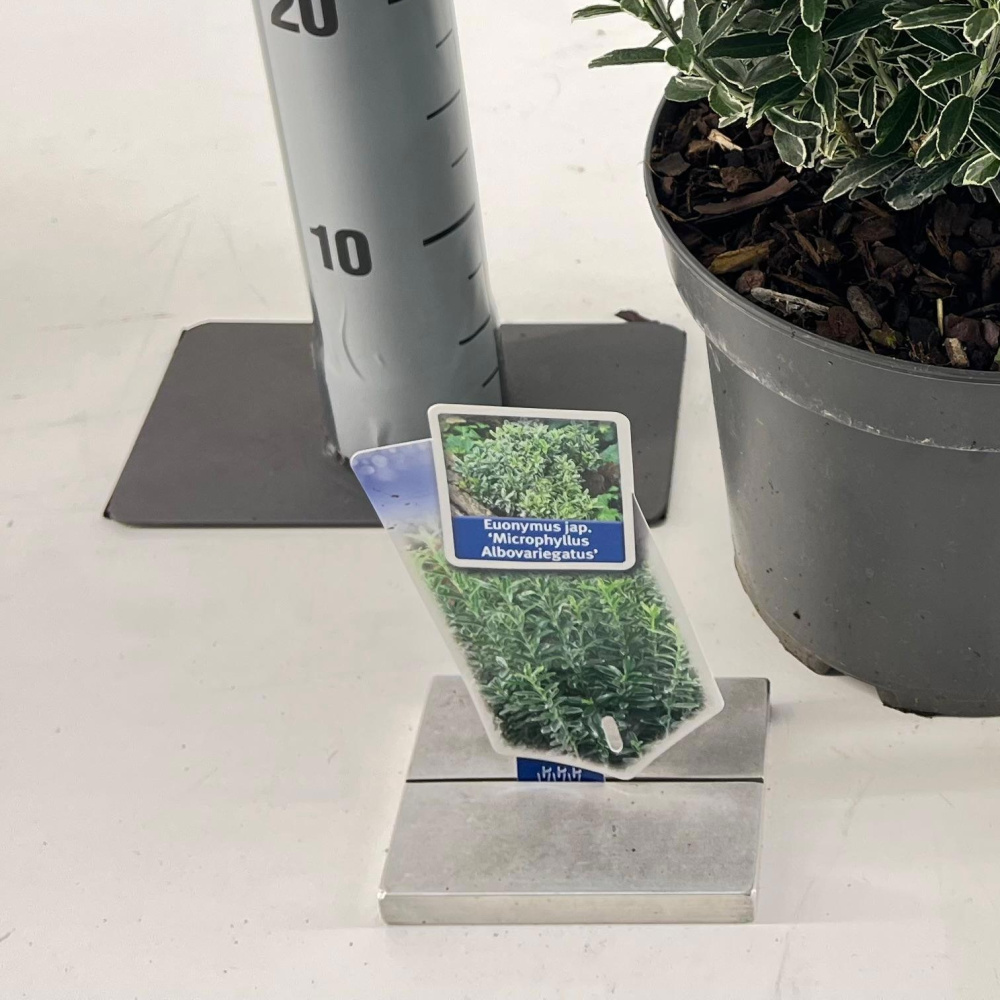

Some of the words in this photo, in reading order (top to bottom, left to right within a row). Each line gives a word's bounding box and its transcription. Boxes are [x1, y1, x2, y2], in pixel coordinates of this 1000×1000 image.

[310, 225, 373, 277] 10
[483, 519, 562, 533] Euonymus
[565, 521, 592, 535] jap.
